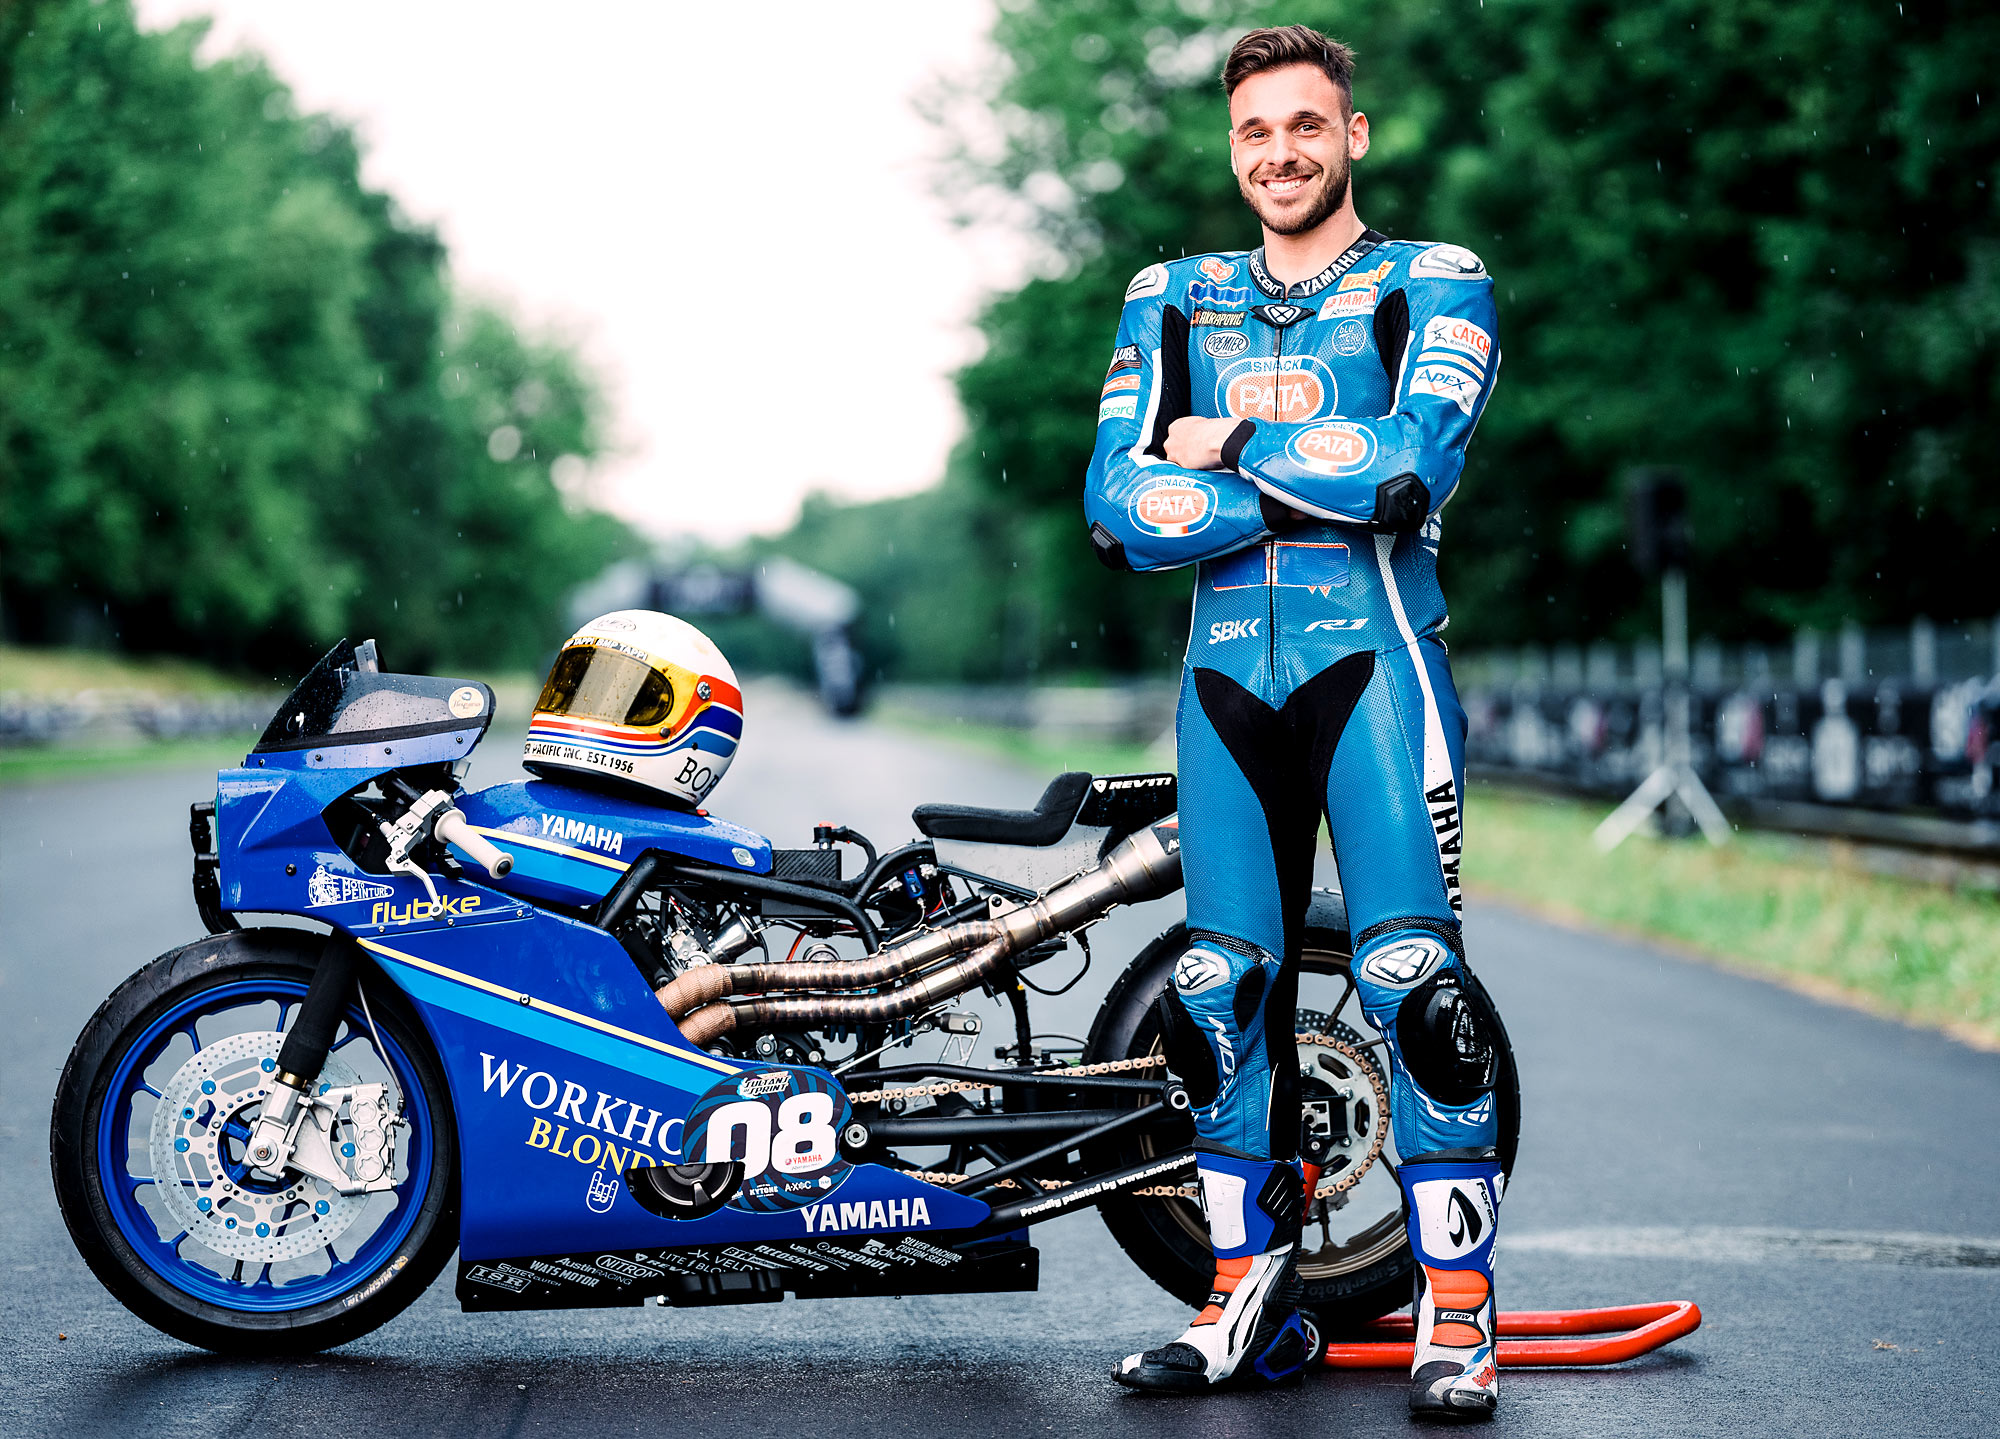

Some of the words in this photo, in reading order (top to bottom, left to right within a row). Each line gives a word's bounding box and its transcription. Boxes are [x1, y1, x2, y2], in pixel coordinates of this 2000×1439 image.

[1204, 261, 1229, 277] PATA
[1250, 251, 1282, 295] CRESCENT
[1300, 249, 1364, 296] YAMAHA
[1208, 335, 1245, 351] PREMIER
[1452, 324, 1490, 357] CATCH
[1251, 359, 1301, 373] SNACK
[1415, 368, 1466, 392] APEX
[1239, 382, 1309, 413] PATA
[1324, 422, 1356, 432] SNACK
[1303, 435, 1355, 458] PATA
[1157, 479, 1193, 489] SNACK
[1146, 495, 1197, 517] PATA
[573, 637, 595, 646] TAPPI
[596, 638, 618, 649] BMP
[618, 643, 648, 662] TAPPI
[532, 744, 560, 757] PACIFIC
[563, 747, 583, 760] INC.
[541, 813, 624, 856] YAMAHA
[342, 879, 365, 890] MOTO
[342, 886, 390, 901] PEINTURE
[371, 894, 481, 926] flybke
[744, 1076, 789, 1088] SULTANS
[749, 1084, 788, 1097] SPRINT
[525, 1116, 677, 1176] BLOND
[705, 1091, 837, 1181] 08
[793, 1154, 823, 1165] YAMAHA
[749, 1185, 779, 1196] KYTONE
[1020, 1197, 1062, 1218] Proudly
[1062, 1183, 1102, 1205] painted
[801, 1197, 932, 1233] YAMAHA
[659, 1250, 688, 1265] LITE
[754, 1244, 829, 1272] ACCOSSATO
[829, 1246, 892, 1270] SPEEDHUT
[895, 1244, 926, 1260] CUSTOM
[925, 1253, 952, 1267] SEATS
[901, 1236, 930, 1252] SILVER
[926, 1246, 963, 1263] MACHINE
[530, 1260, 561, 1276] WATS
[560, 1269, 600, 1288] MOTOR
[600, 1257, 659, 1278] NITRON
[715, 1255, 761, 1272] VELD
[475, 1267, 524, 1288] ISR
[1445, 1312, 1472, 1320] FLOW
